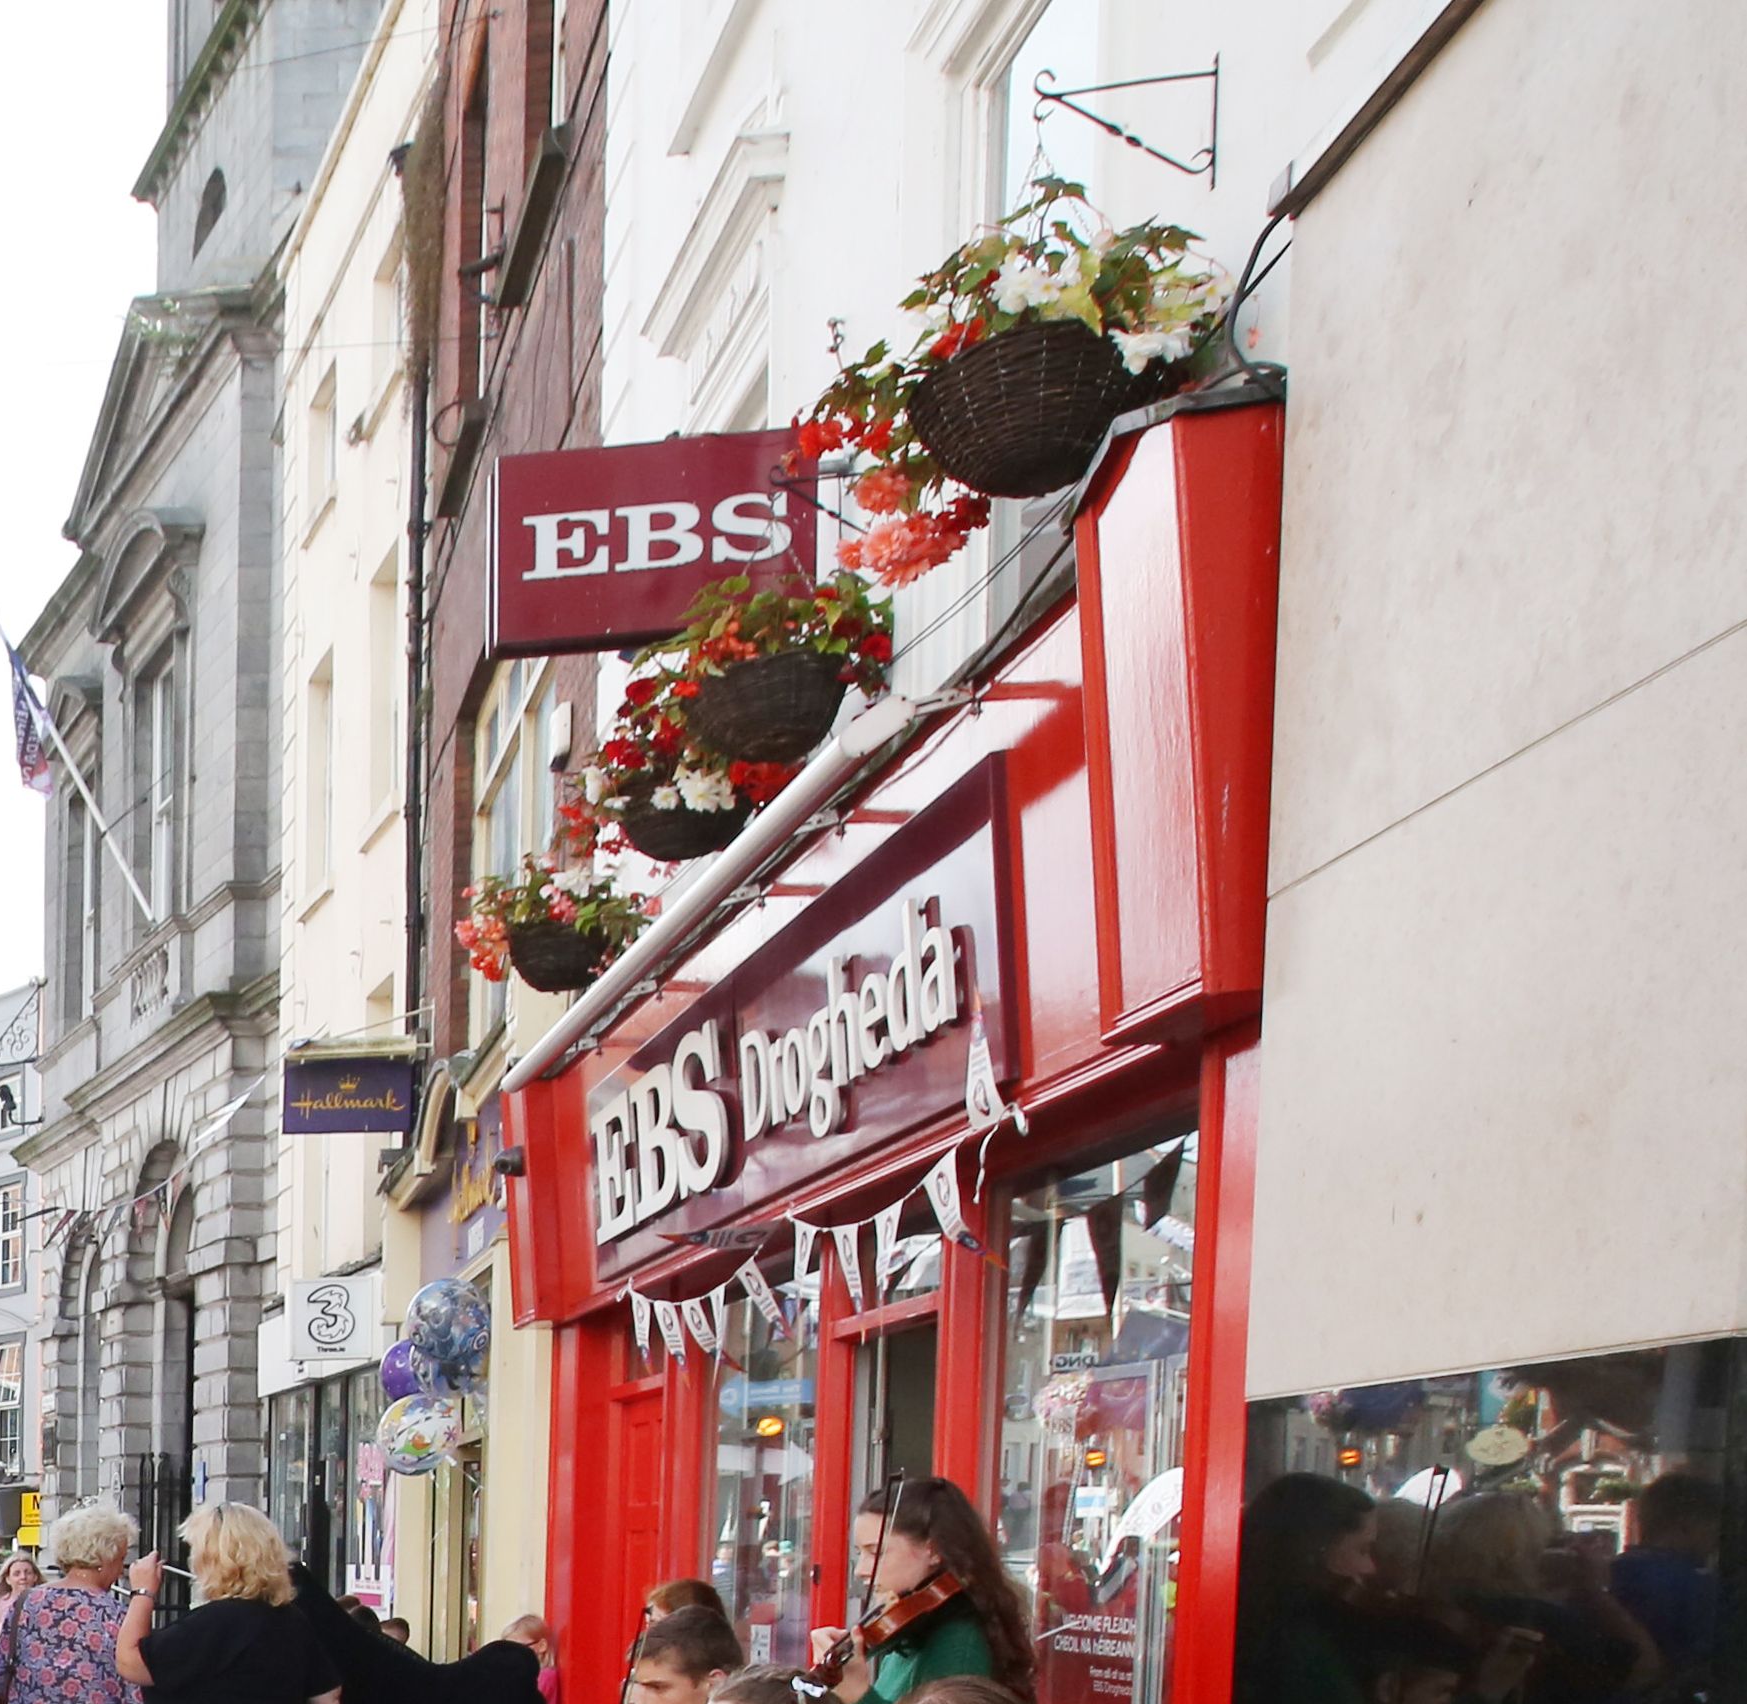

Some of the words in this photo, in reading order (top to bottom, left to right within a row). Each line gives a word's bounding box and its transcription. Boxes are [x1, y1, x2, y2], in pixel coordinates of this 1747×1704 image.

[521, 492, 793, 582] EBS
[590, 1019, 729, 1247] EBS
[740, 897, 958, 1138] Drogheda
[290, 1088, 406, 1120] Hallmark
[307, 1283, 356, 1345] 3
[1054, 1634, 1080, 1652] CHEOIL
[1103, 1615, 1137, 1634] FLEADH
